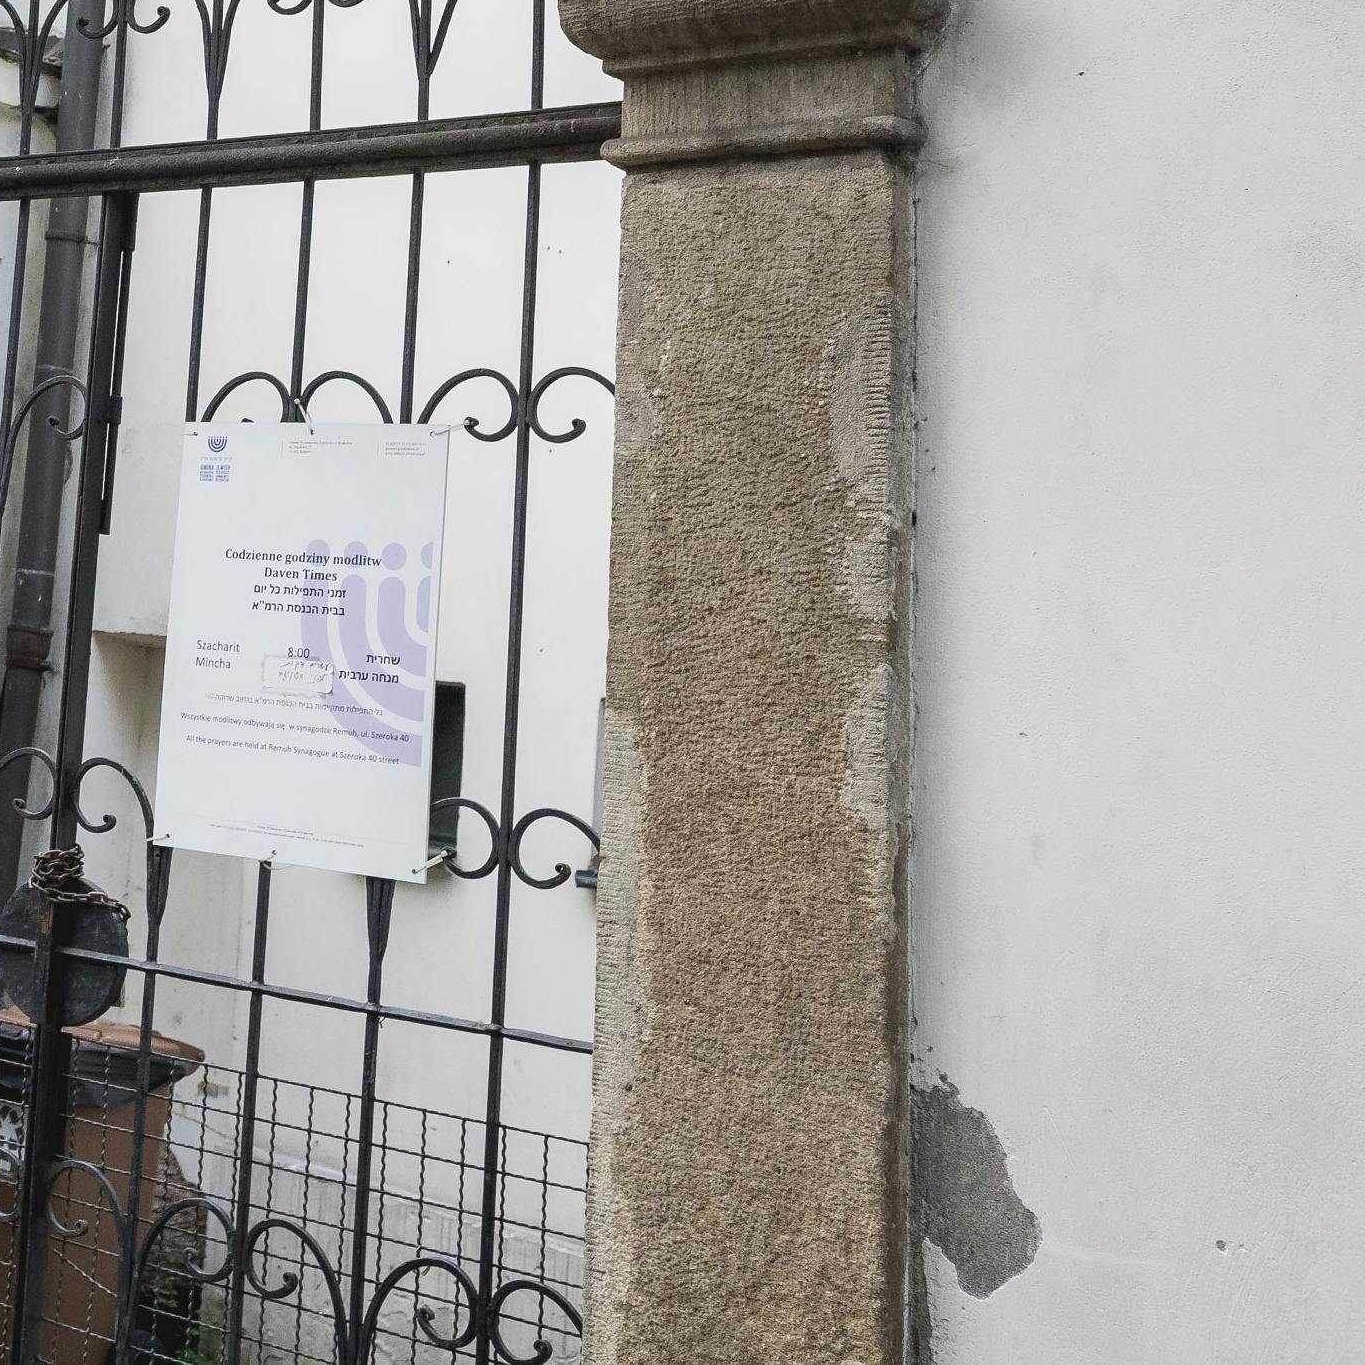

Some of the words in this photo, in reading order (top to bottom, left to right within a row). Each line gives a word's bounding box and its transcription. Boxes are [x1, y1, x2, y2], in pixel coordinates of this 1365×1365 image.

[225, 548, 282, 562] Codzienne
[285, 552, 330, 566] godziny
[333, 553, 382, 567] modlitw
[264, 567, 299, 579] Daven
[302, 569, 338, 581] Times
[253, 584, 267, 594] יום
[270, 583, 281, 595] כל
[283, 584, 324, 597] התפילות
[327, 587, 346, 598] זמני
[287, 604, 319, 615] הכנסת
[322, 605, 346, 616] בבית
[196, 639, 240, 653] Szacharit
[287, 646, 310, 658] 8:00
[195, 656, 231, 669] Mincha
[366, 653, 401, 666] שחרית
[338, 669, 369, 682] ערבית
[371, 672, 399, 684] מנחה
[180, 712, 211, 723] Wszystkie
[212, 715, 242, 726] modlitwy
[243, 718, 275, 730] odbywają
[296, 724, 331, 736] synagodze
[371, 731, 398, 741] Szeroka
[400, 733, 410, 742] 40
[207, 737, 231, 747] prayers
[245, 740, 259, 750] held
[268, 743, 292, 753] Remuh
[293, 746, 329, 758] Synagogue
[340, 750, 366, 761] Szeroka
[368, 753, 378, 762] 40
[378, 755, 399, 765] street
